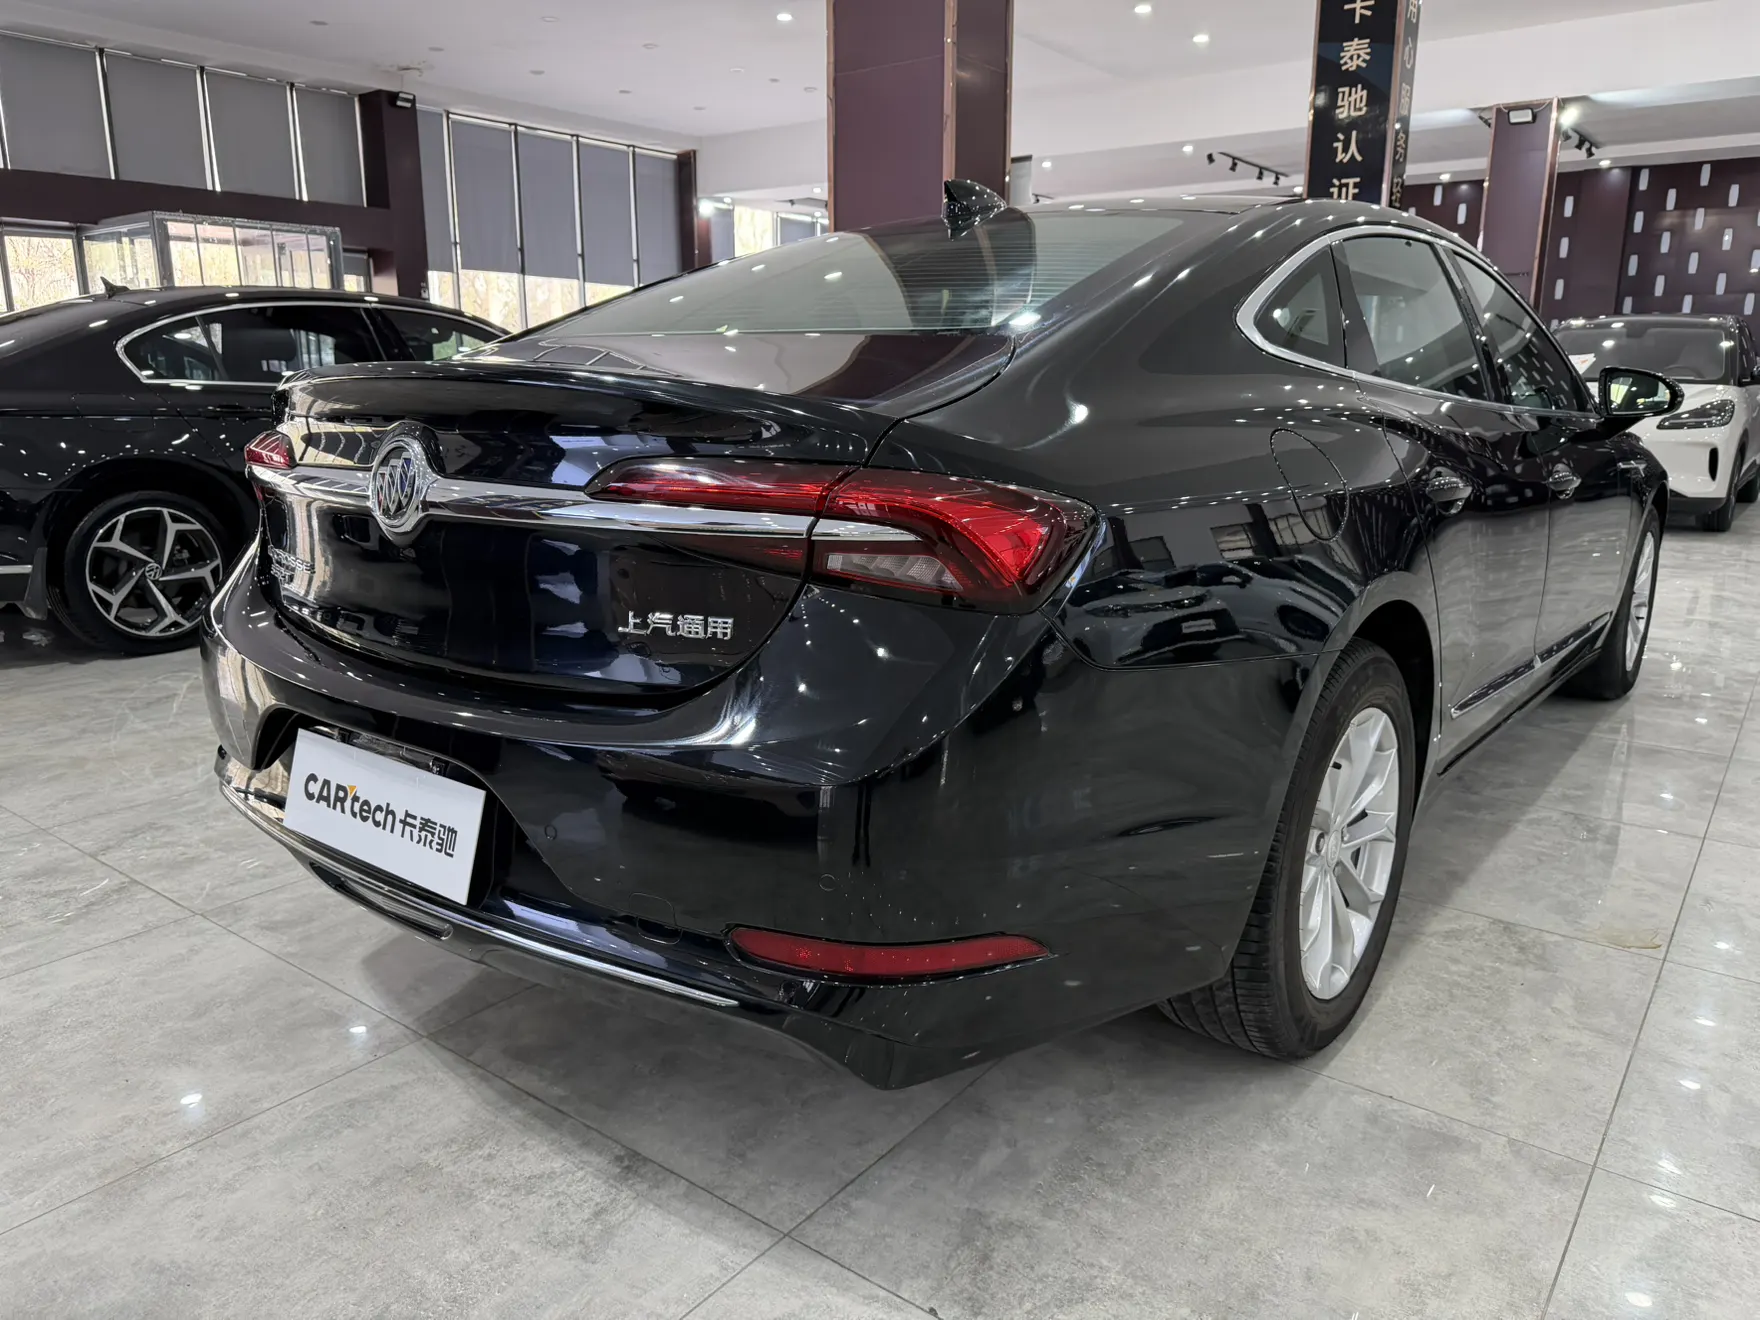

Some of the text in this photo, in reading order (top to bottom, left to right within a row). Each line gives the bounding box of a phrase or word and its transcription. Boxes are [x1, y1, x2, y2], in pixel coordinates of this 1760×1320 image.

[1330, 0, 1375, 200] 卡泰驰认证
[618, 611, 734, 640] 上汽通用
[304, 773, 458, 858] CARtech 卡泰驰
